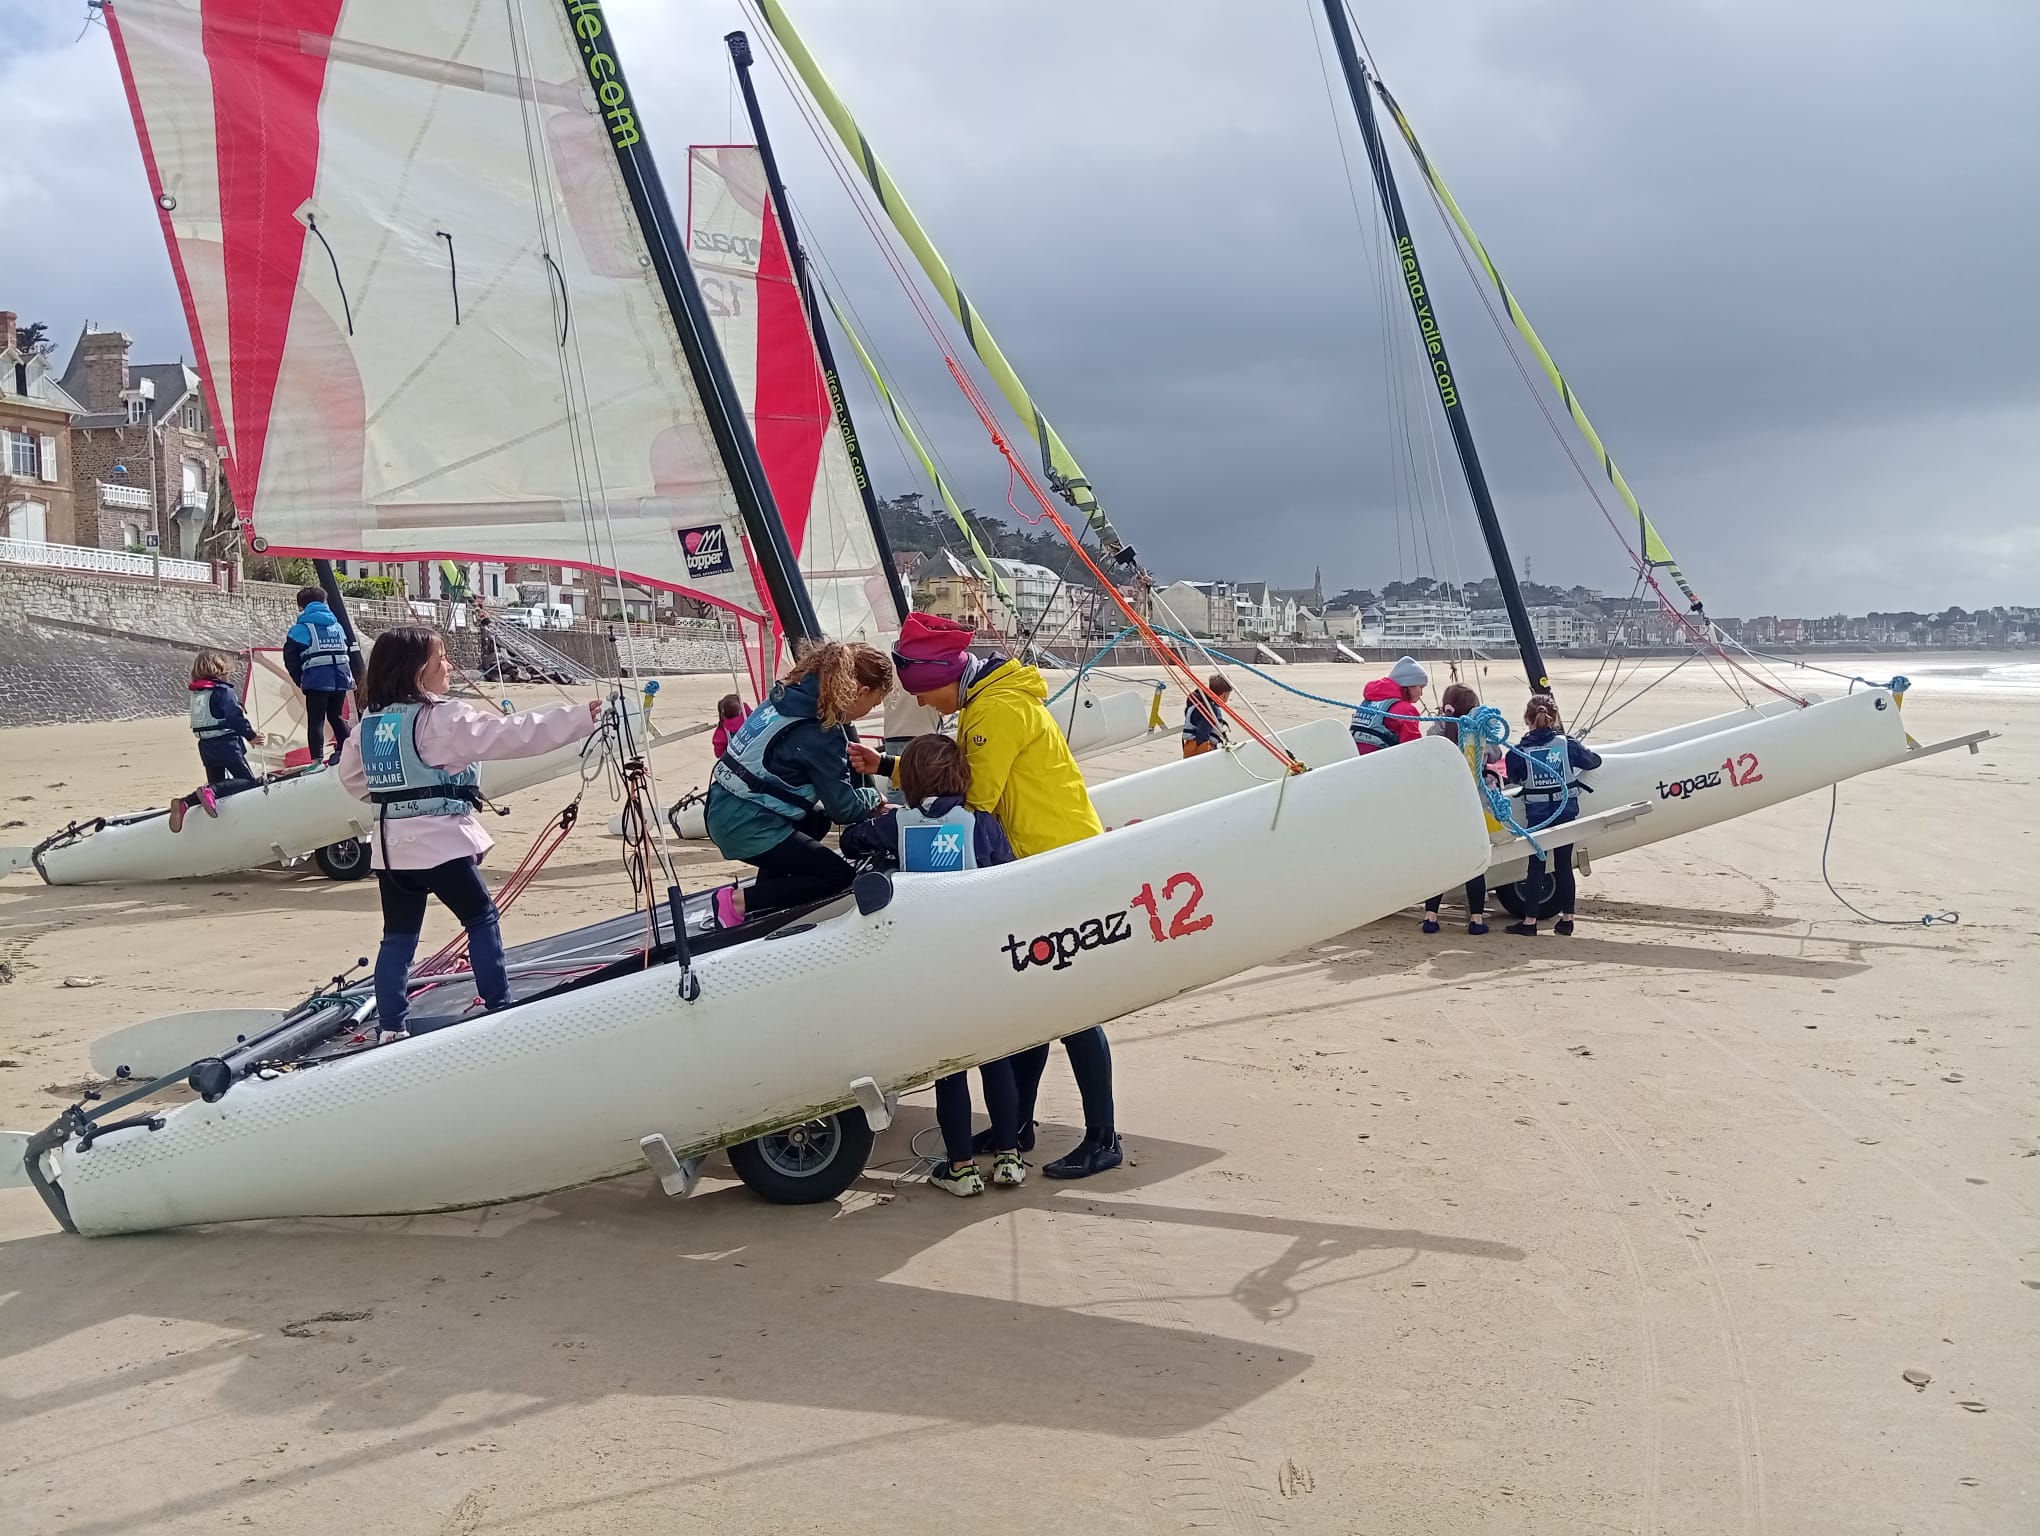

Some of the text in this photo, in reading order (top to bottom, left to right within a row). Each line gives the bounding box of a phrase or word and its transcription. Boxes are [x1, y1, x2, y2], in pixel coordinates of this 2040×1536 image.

[1398, 236, 1458, 408] sirena-voile.com
[825, 369, 868, 490] sirena-voile.com
[687, 552, 724, 570] topper
[1656, 753, 1763, 800] topaz 12
[1001, 872, 1214, 972] topaz 12
